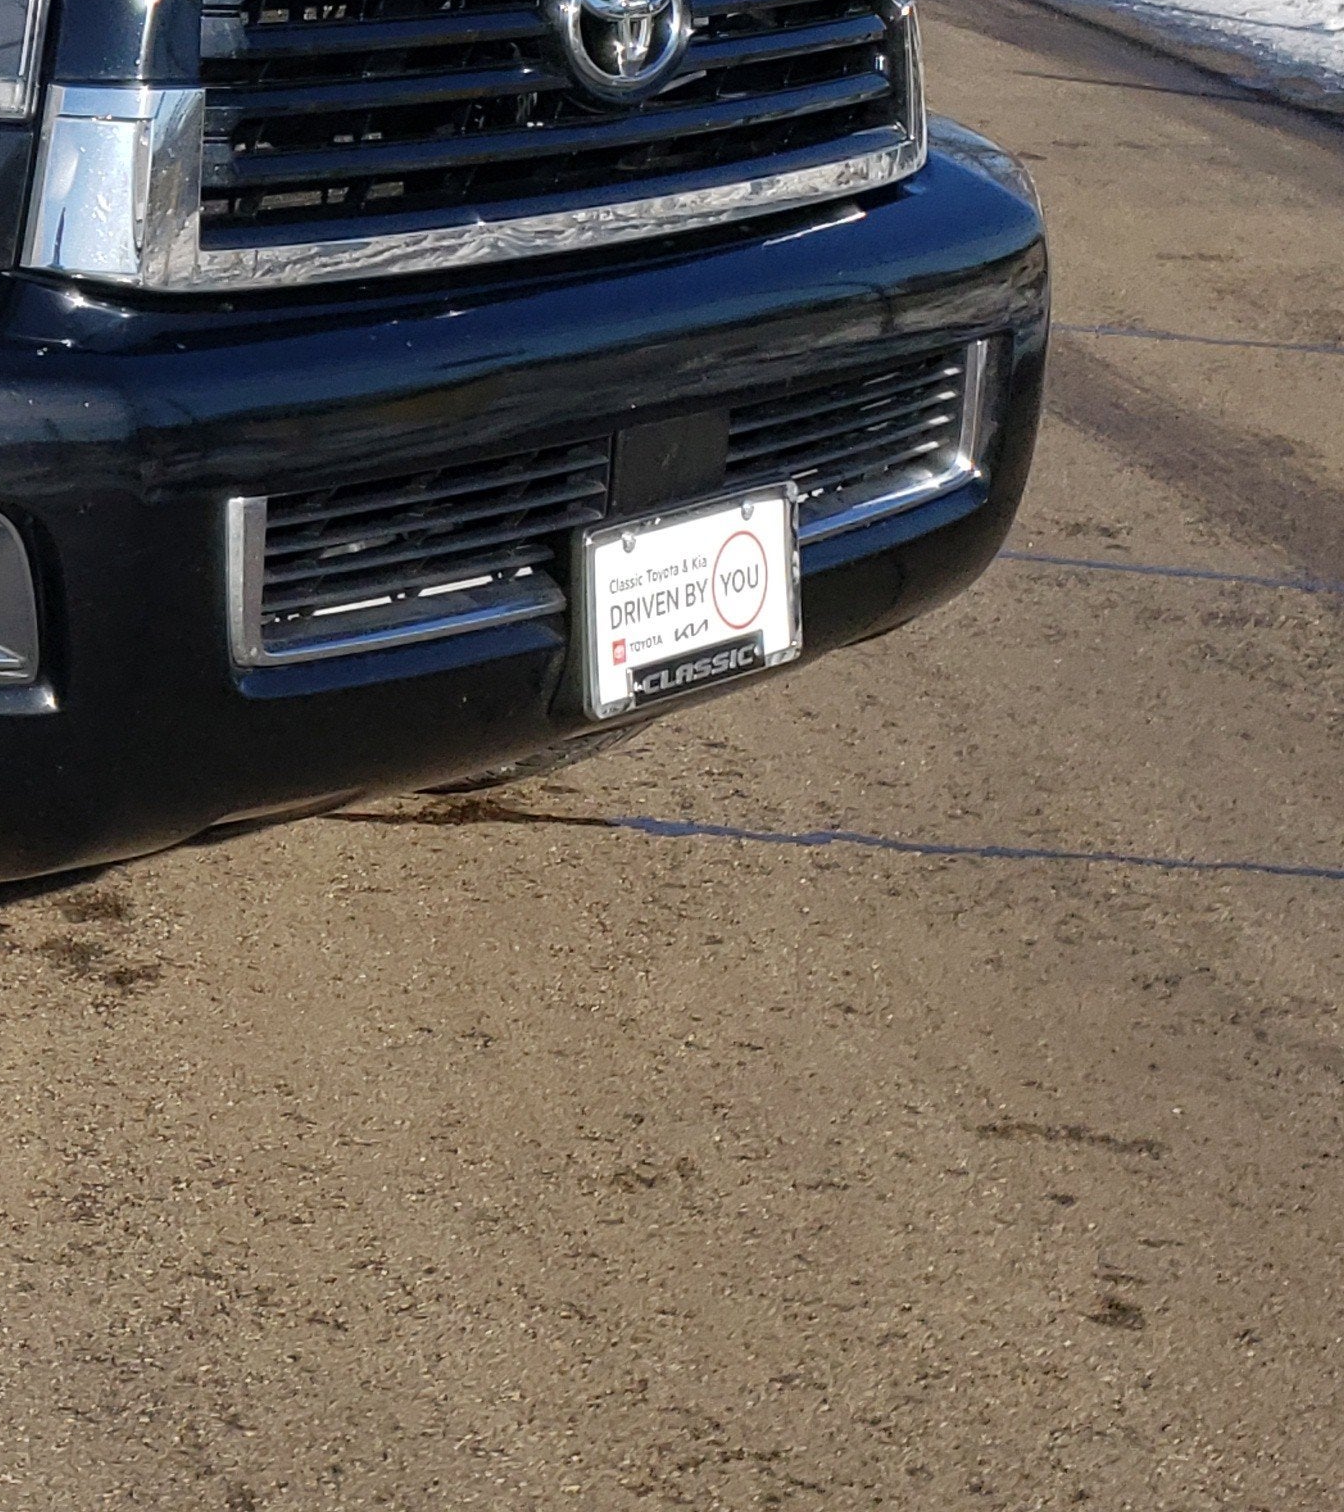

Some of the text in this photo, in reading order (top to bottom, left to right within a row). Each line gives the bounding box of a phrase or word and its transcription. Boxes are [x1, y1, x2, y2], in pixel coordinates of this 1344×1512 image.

[609, 574, 644, 595] Classic
[610, 563, 759, 630] DRIVEN BY YOU
[629, 634, 663, 652] TOYOTA
[643, 643, 756, 694] CLASSIC
